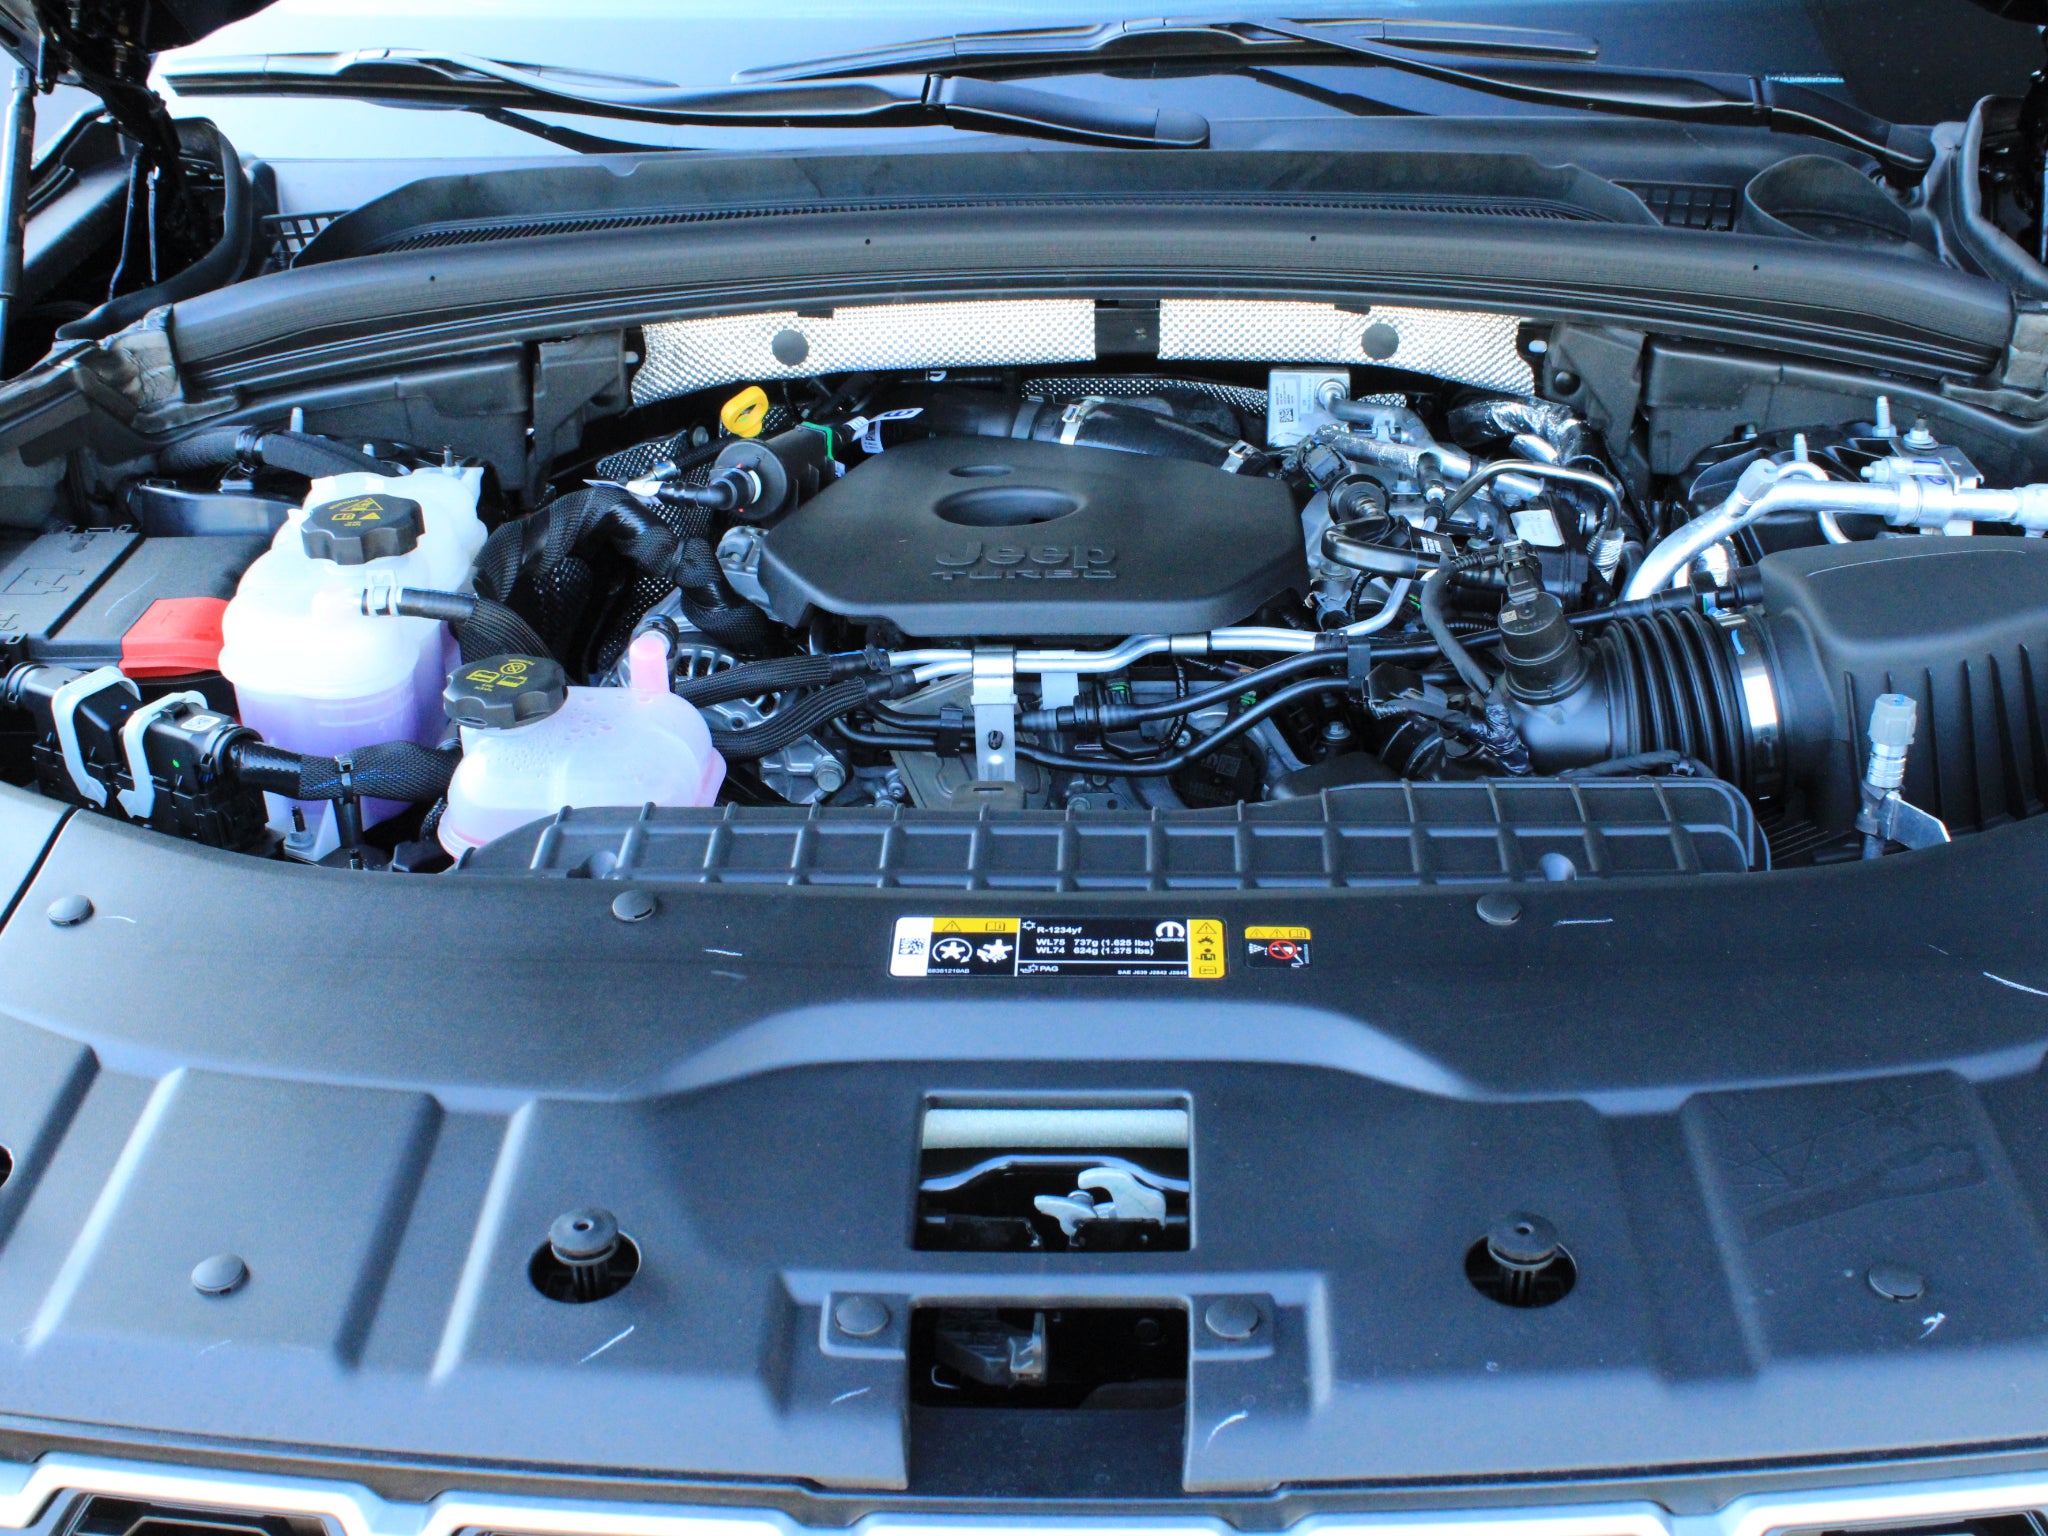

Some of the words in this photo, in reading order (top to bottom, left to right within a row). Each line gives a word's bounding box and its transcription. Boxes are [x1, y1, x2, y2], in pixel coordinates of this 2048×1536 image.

[935, 541, 1116, 569] Jeep
[1036, 926, 1083, 935] R-1234yf
[1073, 938, 1099, 948] 737g
[1134, 939, 1154, 948] lbs)
[1035, 946, 1066, 954] WL74
[1073, 946, 1099, 956] 624g
[1100, 947, 1132, 956] (1.375
[1134, 947, 1154, 957] lbs)
